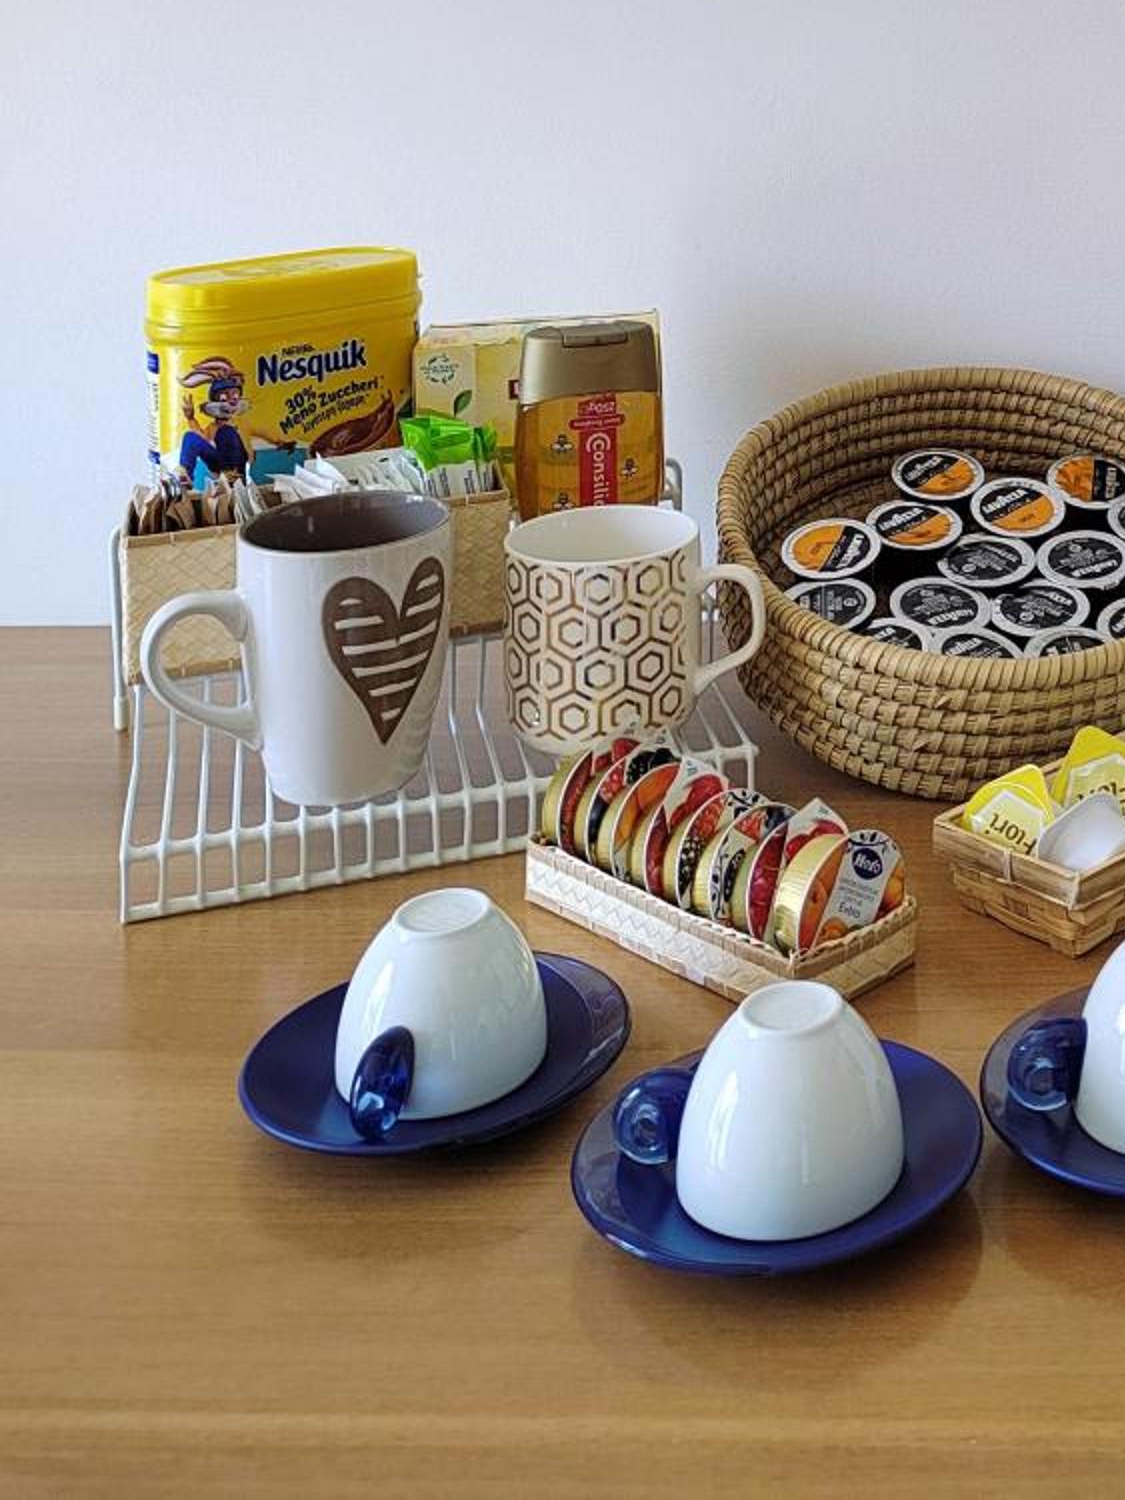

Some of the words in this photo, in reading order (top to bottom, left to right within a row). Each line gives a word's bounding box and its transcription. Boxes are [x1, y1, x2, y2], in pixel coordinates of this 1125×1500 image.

[257, 339, 367, 388] Nesquik
[285, 384, 318, 414] 30%
[279, 402, 319, 435] Meno
